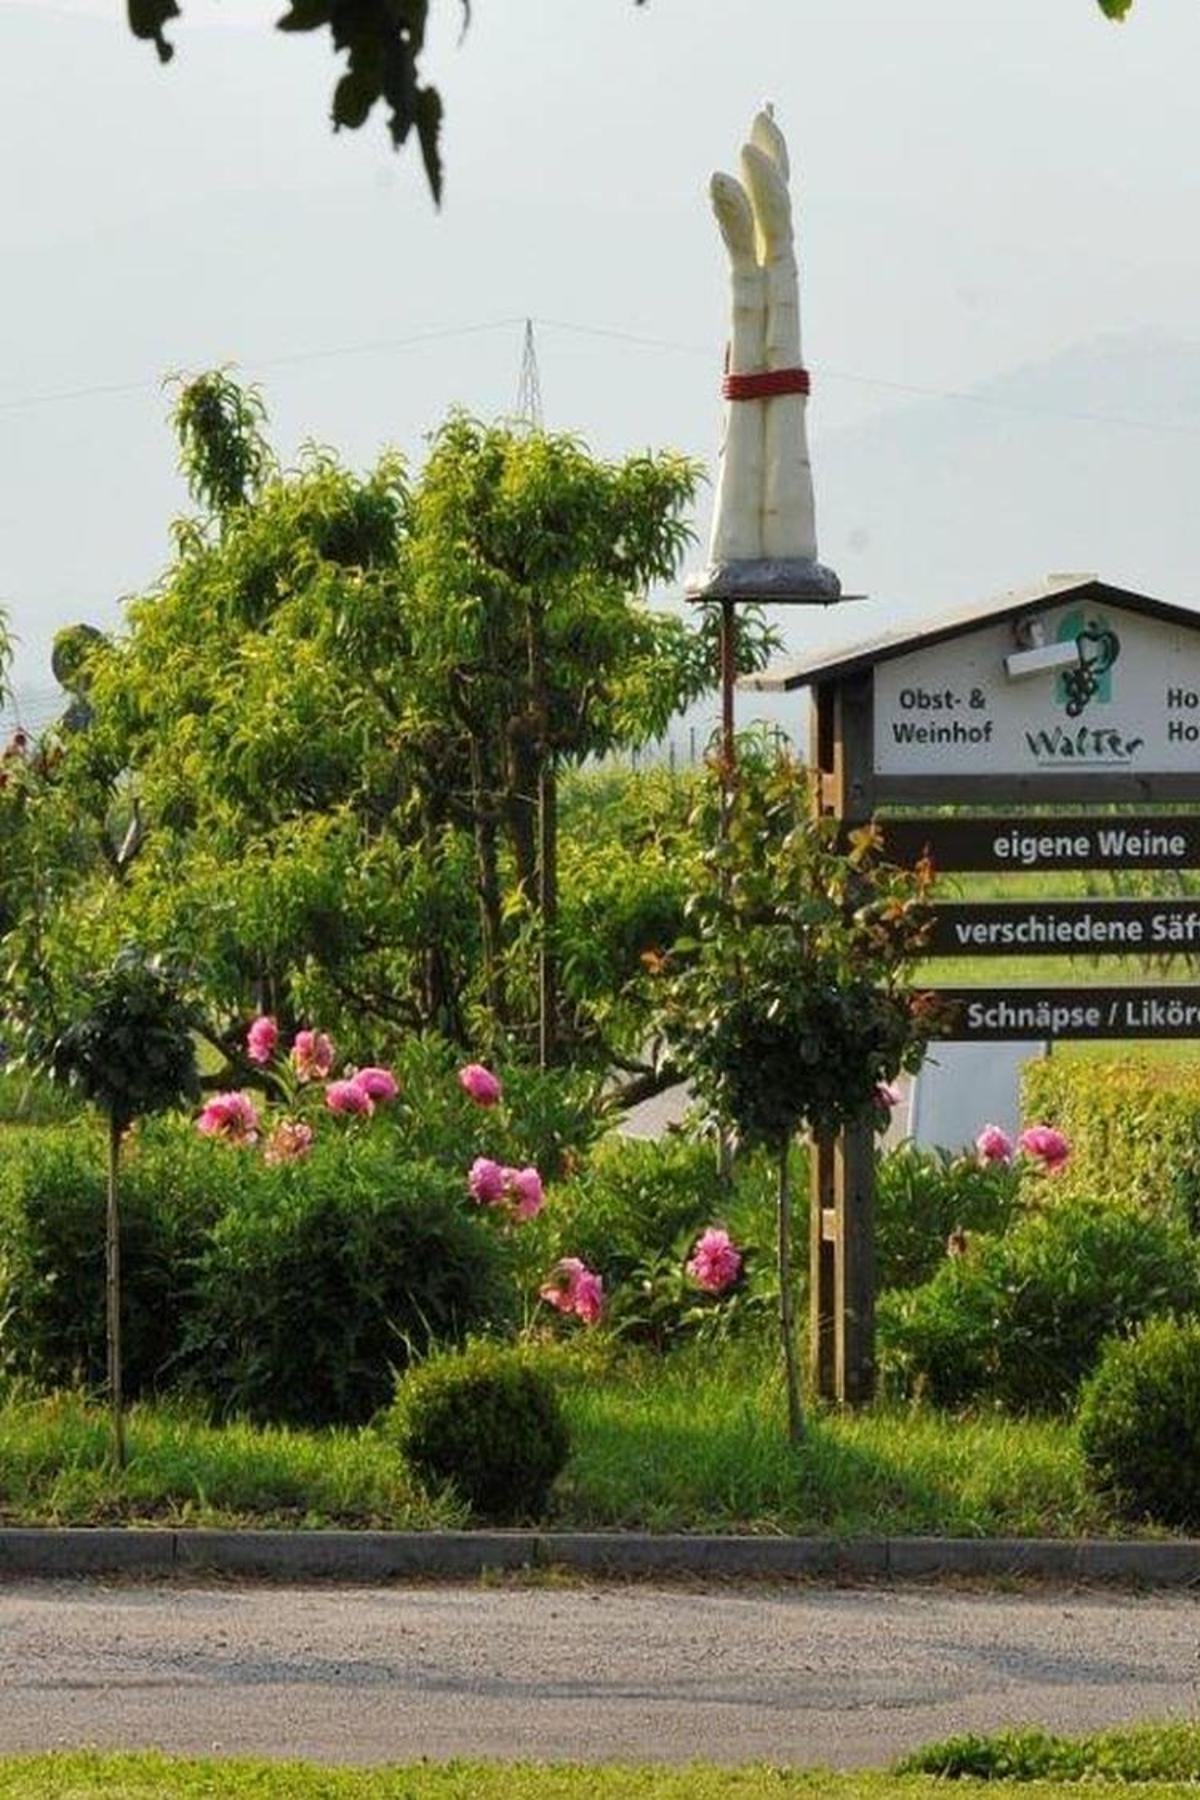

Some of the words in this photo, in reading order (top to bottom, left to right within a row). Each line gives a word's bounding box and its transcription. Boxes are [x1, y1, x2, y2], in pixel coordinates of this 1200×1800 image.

[899, 688, 962, 711] Obst-
[968, 689, 987, 711] &
[892, 721, 994, 745] Weinhof
[993, 830, 1091, 863] eigene
[1097, 831, 1188, 857] Weine
[955, 915, 1143, 944] verschiedene
[967, 1002, 1101, 1032] Schnäpse
[1107, 1003, 1119, 1028] /
